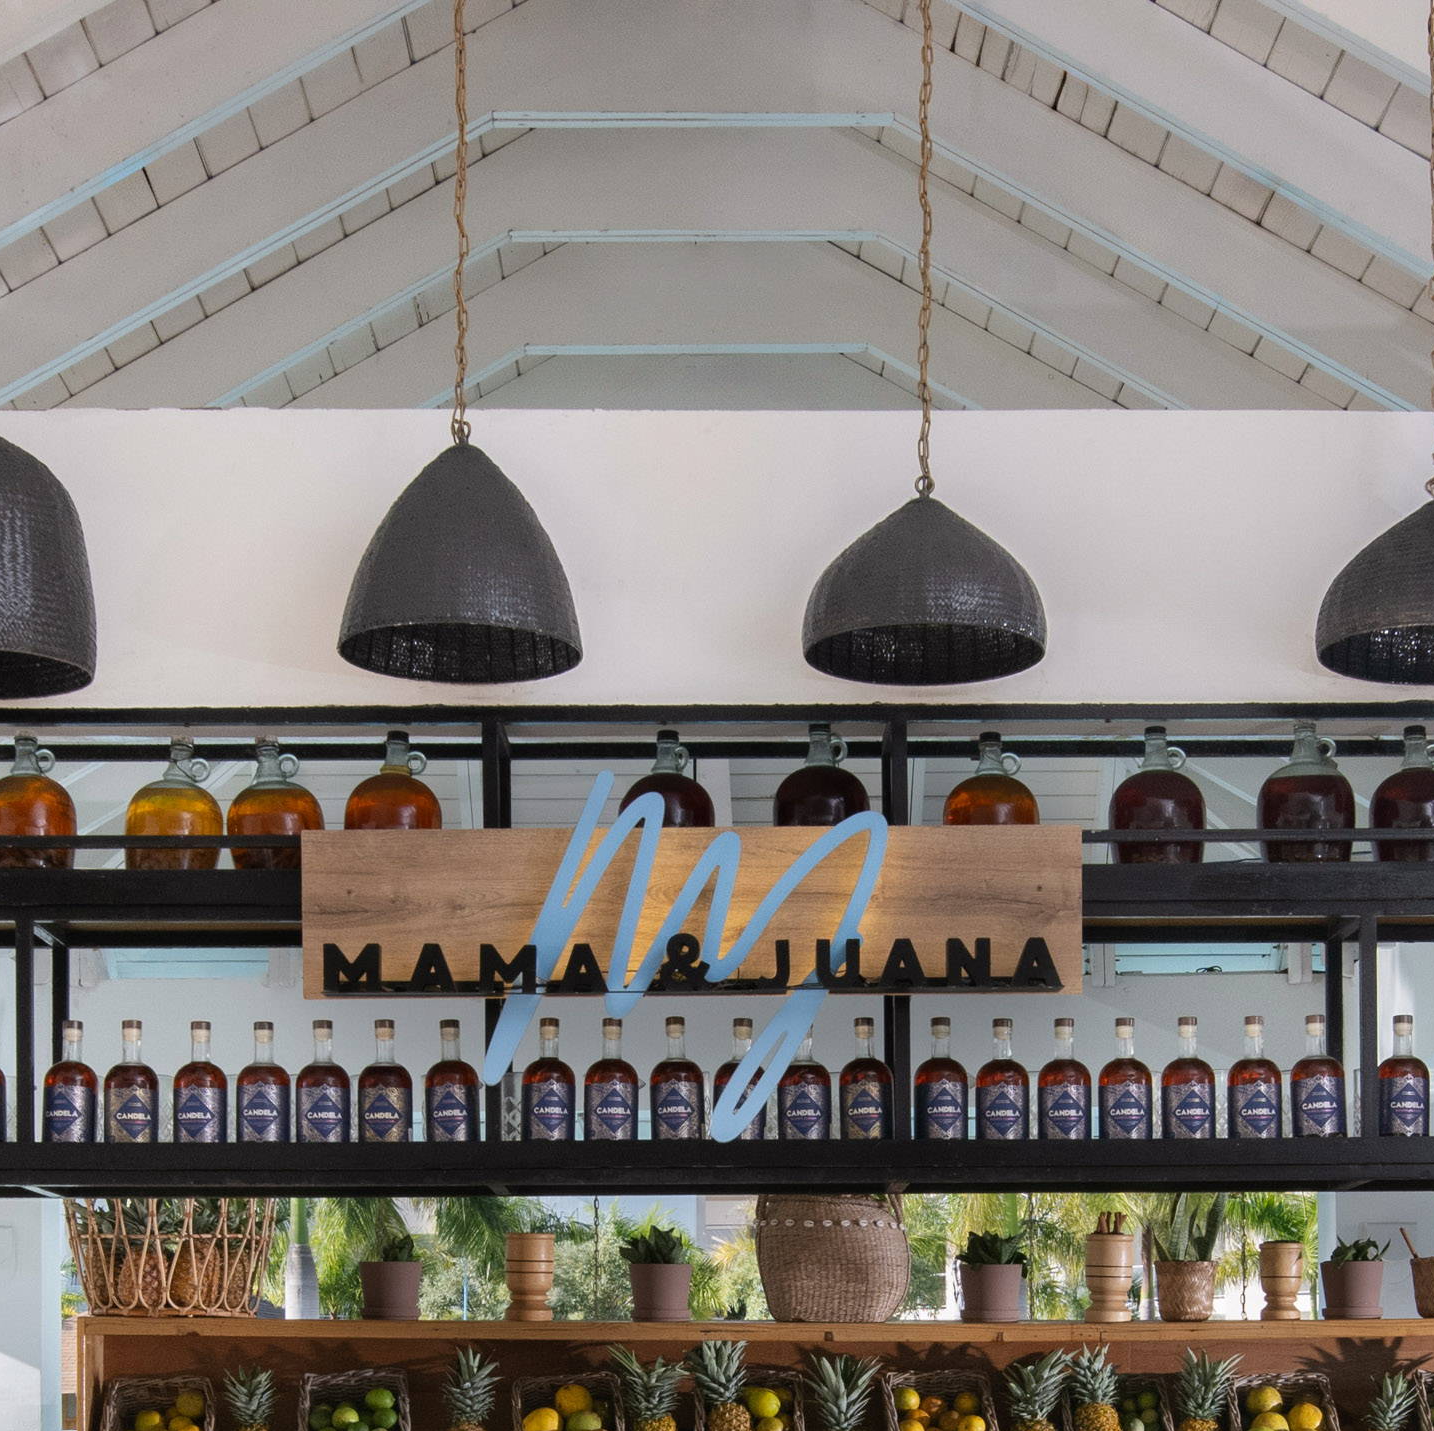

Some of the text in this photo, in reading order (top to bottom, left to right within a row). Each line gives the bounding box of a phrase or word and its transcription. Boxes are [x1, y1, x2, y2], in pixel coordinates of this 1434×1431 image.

[322, 932, 1064, 996] MAMA & JUANA
[657, 1105, 692, 1114] CANDELA
[926, 1105, 962, 1114] CANDELA
[1301, 1101, 1338, 1111] CANDELA
[1390, 1101, 1425, 1110] CANDELA
[45, 1109, 79, 1119] CANDELA
[242, 1108, 278, 1118] CANDELA
[432, 1108, 467, 1119] CANDELA
[533, 1106, 569, 1115] CANDELA
[595, 1106, 631, 1115] CANDELA
[785, 1108, 821, 1118] CANDELA
[847, 1106, 883, 1115] CANDELA
[985, 1108, 1021, 1118] CANDELA
[1048, 1108, 1084, 1118] CANDELA
[1109, 1107, 1145, 1117] CANDELA
[1174, 1107, 1210, 1117] CANDELA
[1241, 1108, 1277, 1117] CANDELA
[115, 1112, 152, 1121] CANDELA
[176, 1111, 212, 1120] CANDELA
[306, 1111, 343, 1120] CANDELA
[364, 1111, 400, 1120] CANDELA
